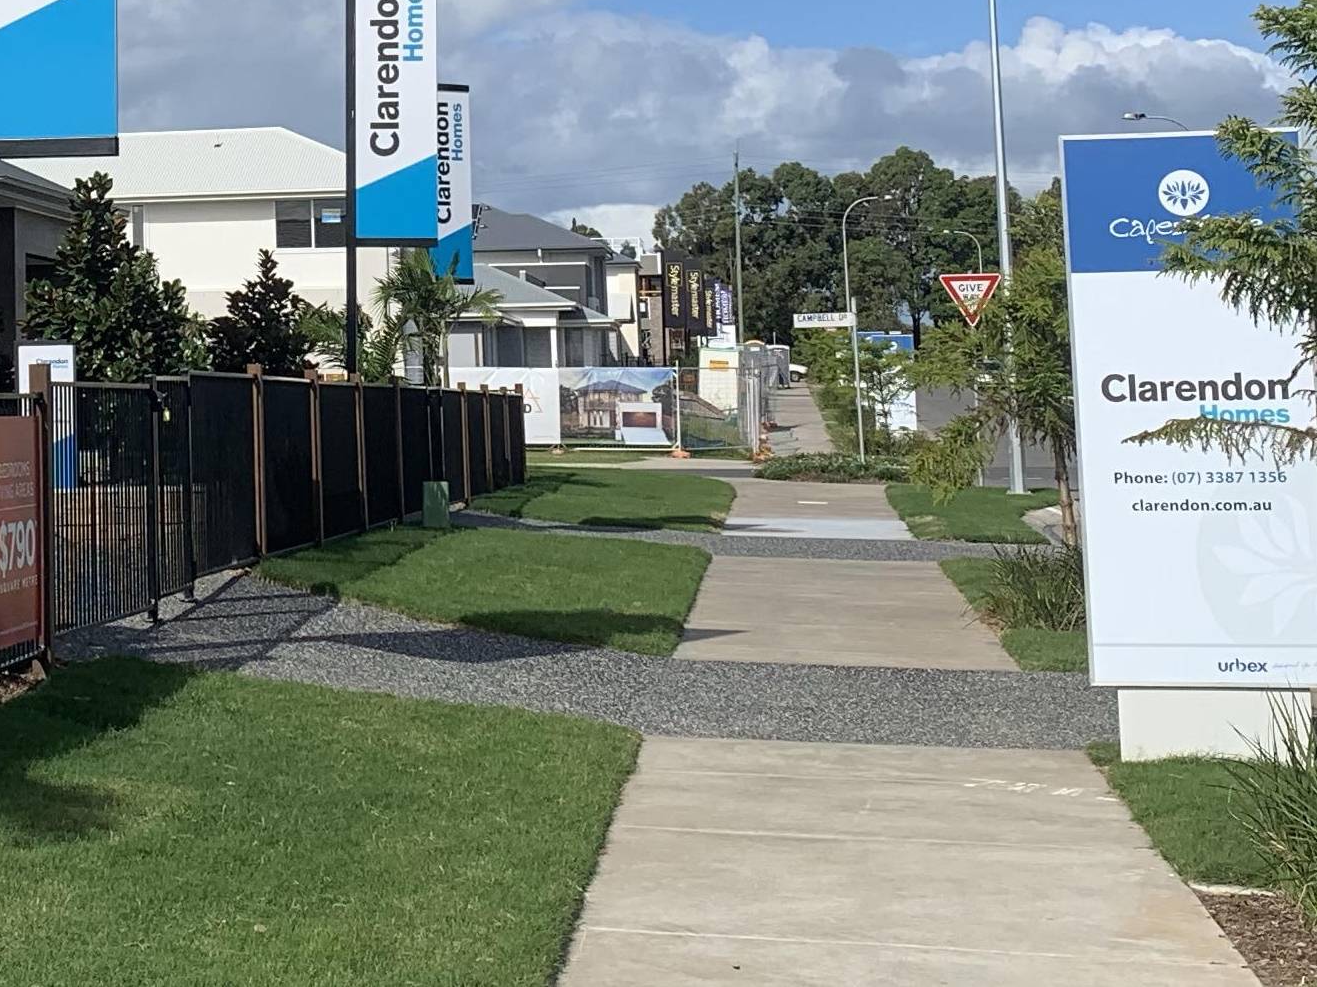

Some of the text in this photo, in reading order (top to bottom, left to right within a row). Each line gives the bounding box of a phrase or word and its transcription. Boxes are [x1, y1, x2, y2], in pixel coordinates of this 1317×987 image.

[452, 102, 463, 162] Homes
[669, 265, 680, 317] Stylemaster
[958, 283, 984, 293] GIVE
[797, 313, 836, 323] CAMPBELL
[1101, 372, 1290, 403] Clarendon
[1199, 404, 1290, 424] Homes
[1114, 471, 1288, 486] Phone: (07) 3387 1356
[1132, 498, 1272, 512] clarendon.com.au
[1217, 658, 1268, 673] urbex
